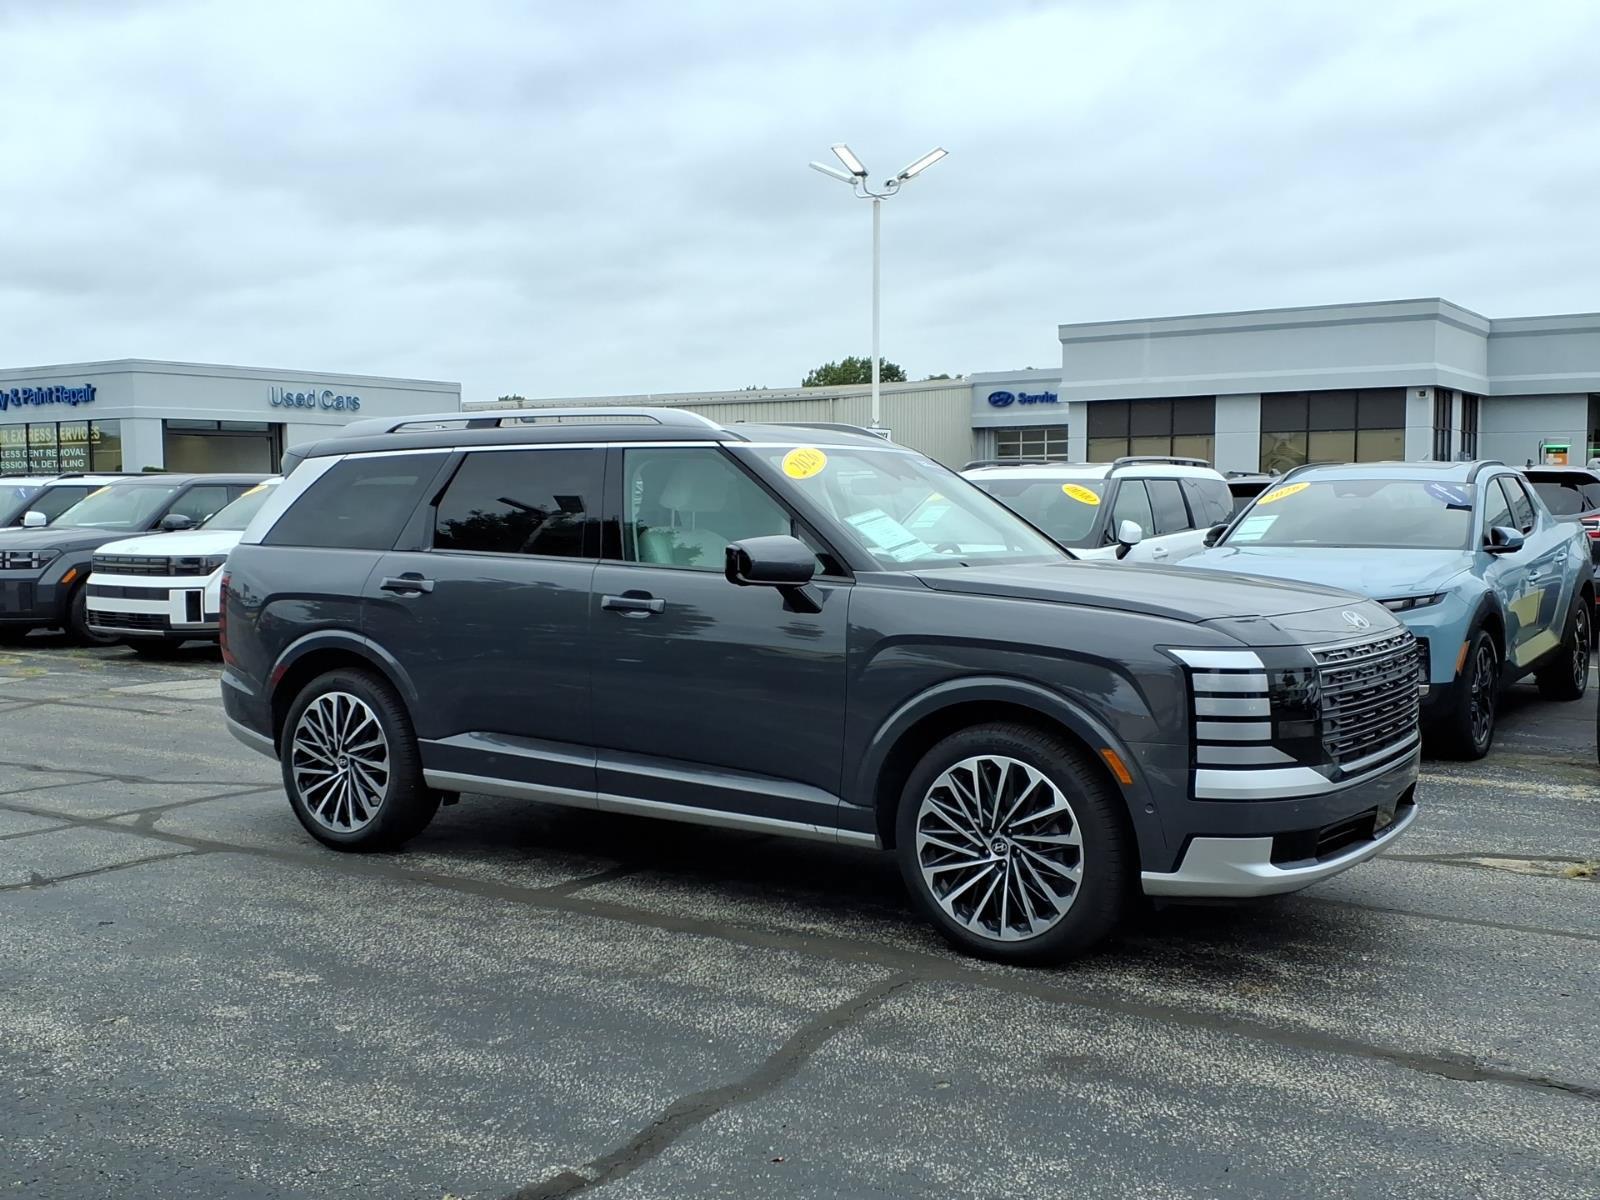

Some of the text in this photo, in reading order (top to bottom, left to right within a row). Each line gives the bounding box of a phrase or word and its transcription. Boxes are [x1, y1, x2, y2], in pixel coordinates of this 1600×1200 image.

[10, 388, 21, 407] &
[22, 386, 54, 406] Paint
[54, 383, 96, 406] Repair
[270, 386, 361, 411] Used Cars
[1018, 391, 1057, 405] Servic
[54, 425, 100, 442] ERVICS
[41, 459, 84, 468] DETILING
